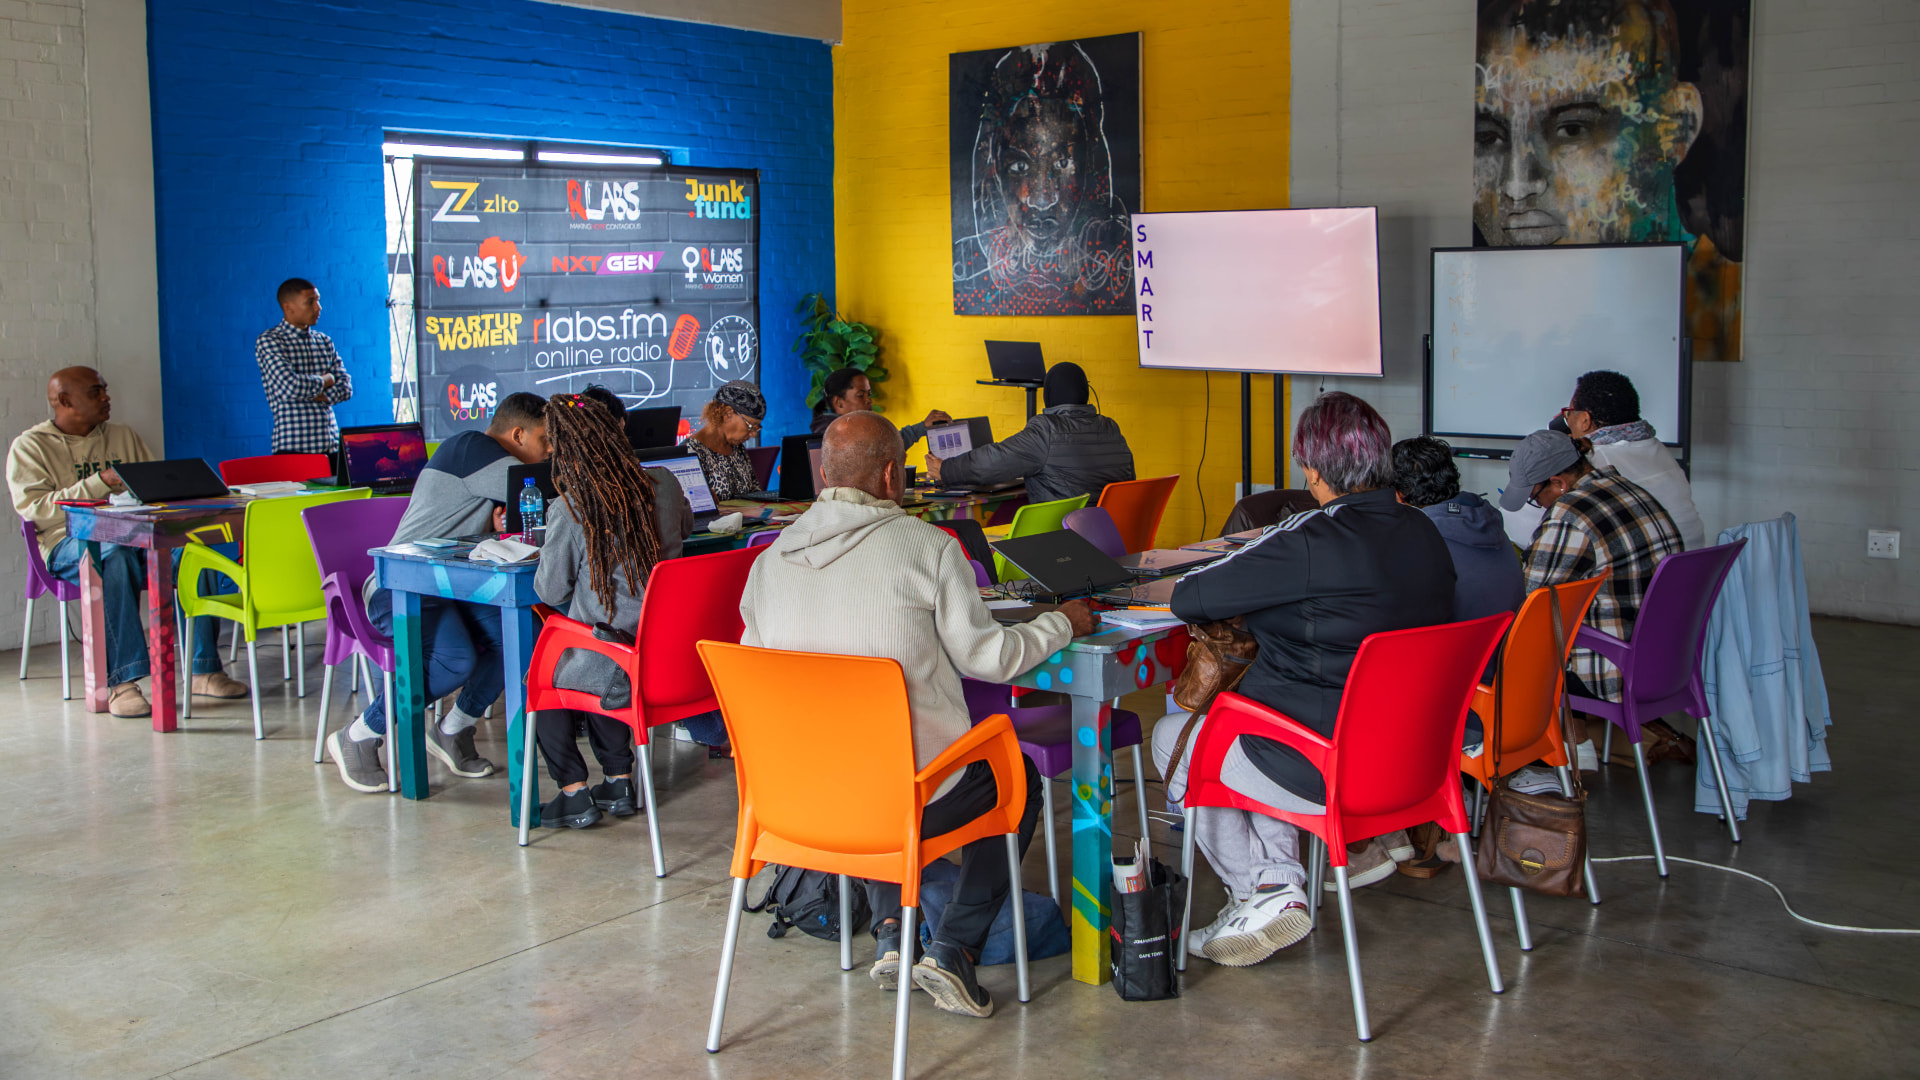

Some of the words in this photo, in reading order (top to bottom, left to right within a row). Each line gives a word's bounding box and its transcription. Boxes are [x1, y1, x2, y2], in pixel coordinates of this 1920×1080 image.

[567, 179, 640, 221] RLABS
[685, 178, 745, 203] Junk
[483, 194, 519, 213] zlto
[552, 256, 603, 272] NXT
[606, 254, 654, 271] GEN
[701, 247, 743, 272] RLABS
[703, 272, 743, 283] Women
[425, 312, 523, 335] STARTUP
[533, 308, 667, 344] rlabs.fm
[437, 329, 518, 351] WOMEN
[535, 345, 603, 368] online
[610, 342, 661, 363] radio
[448, 382, 497, 409] RLABS
[450, 408, 496, 421] YOUTH
